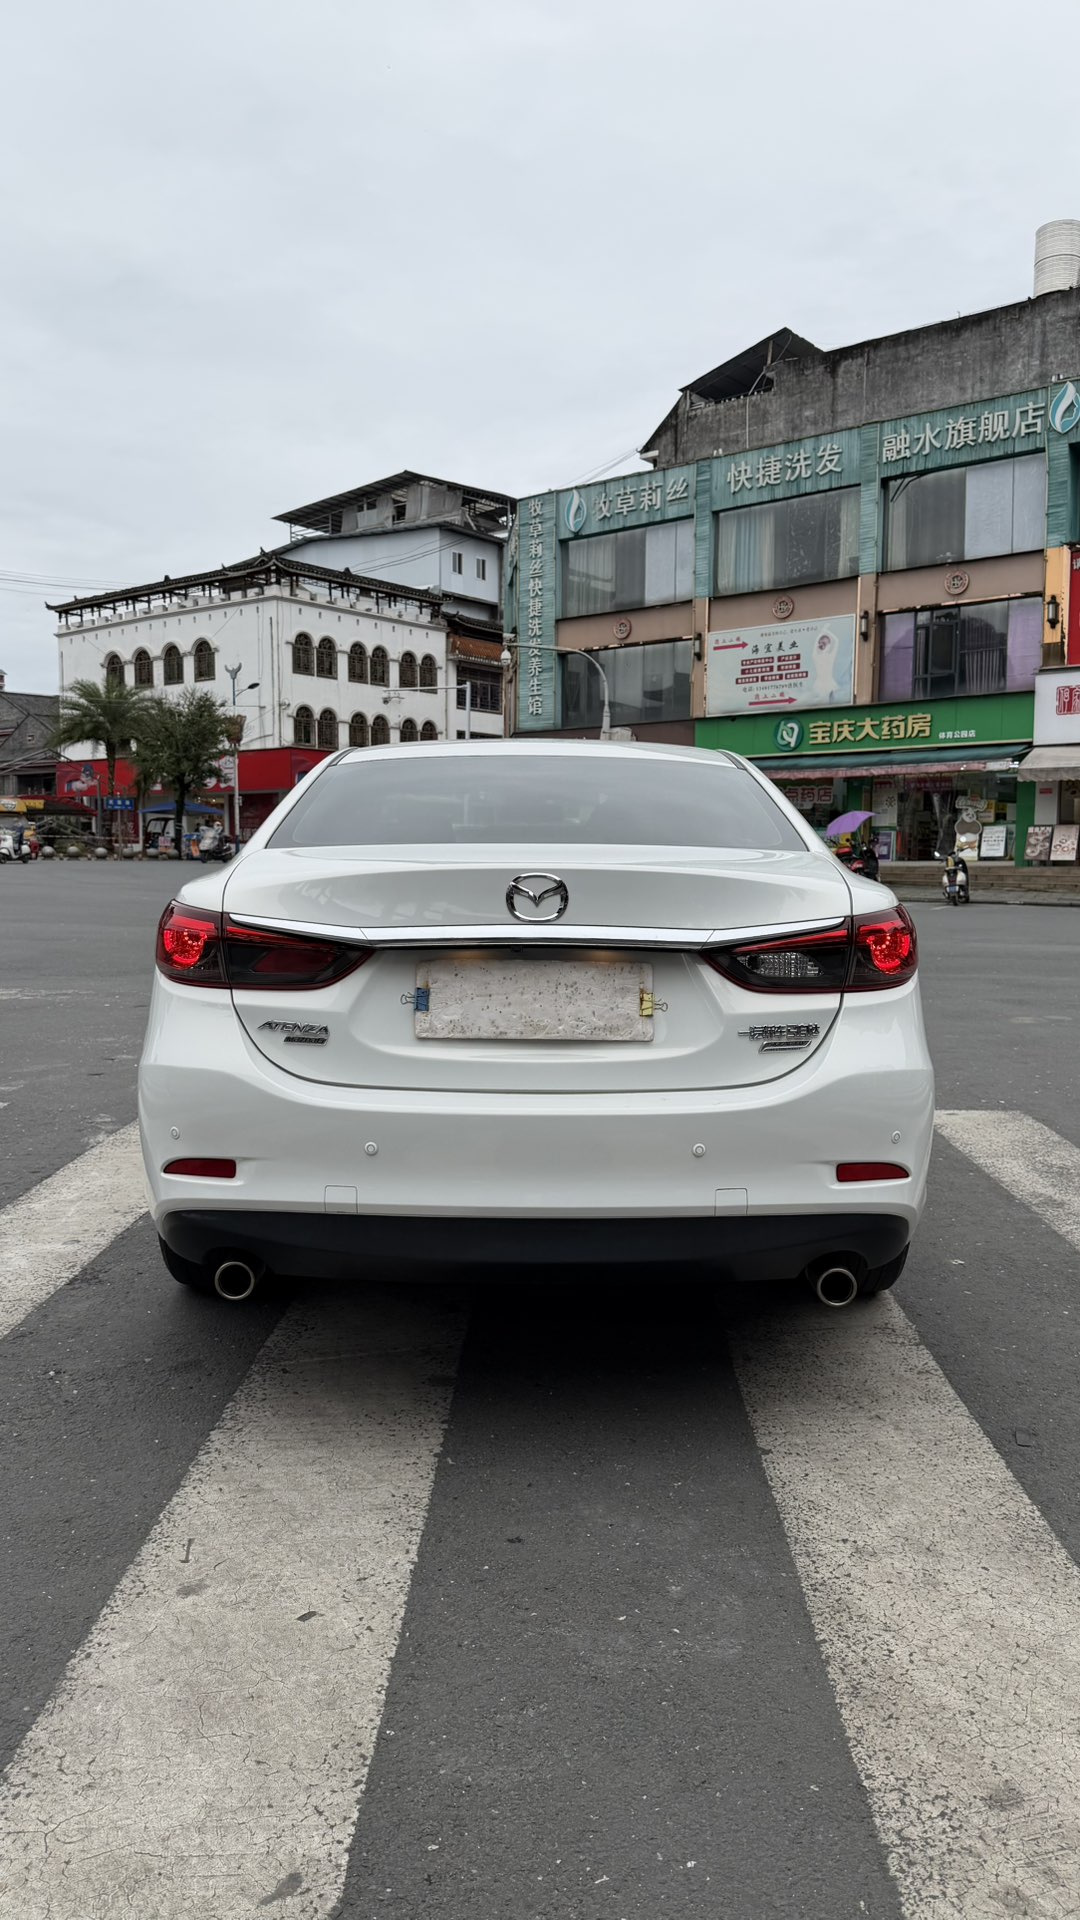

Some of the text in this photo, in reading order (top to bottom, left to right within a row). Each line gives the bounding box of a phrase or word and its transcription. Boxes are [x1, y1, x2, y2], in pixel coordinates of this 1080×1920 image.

[882, 402, 1046, 463] 融水旗舰店
[727, 443, 843, 494] 快捷洗发
[592, 477, 689, 521] 牧草莉丝
[528, 499, 543, 716] 牧草莉丝快捷洗发养生馆
[808, 713, 932, 745] 宝庆大药房
[938, 730, 976, 739] 体育公园店
[257, 1020, 329, 1035] ATENZA
